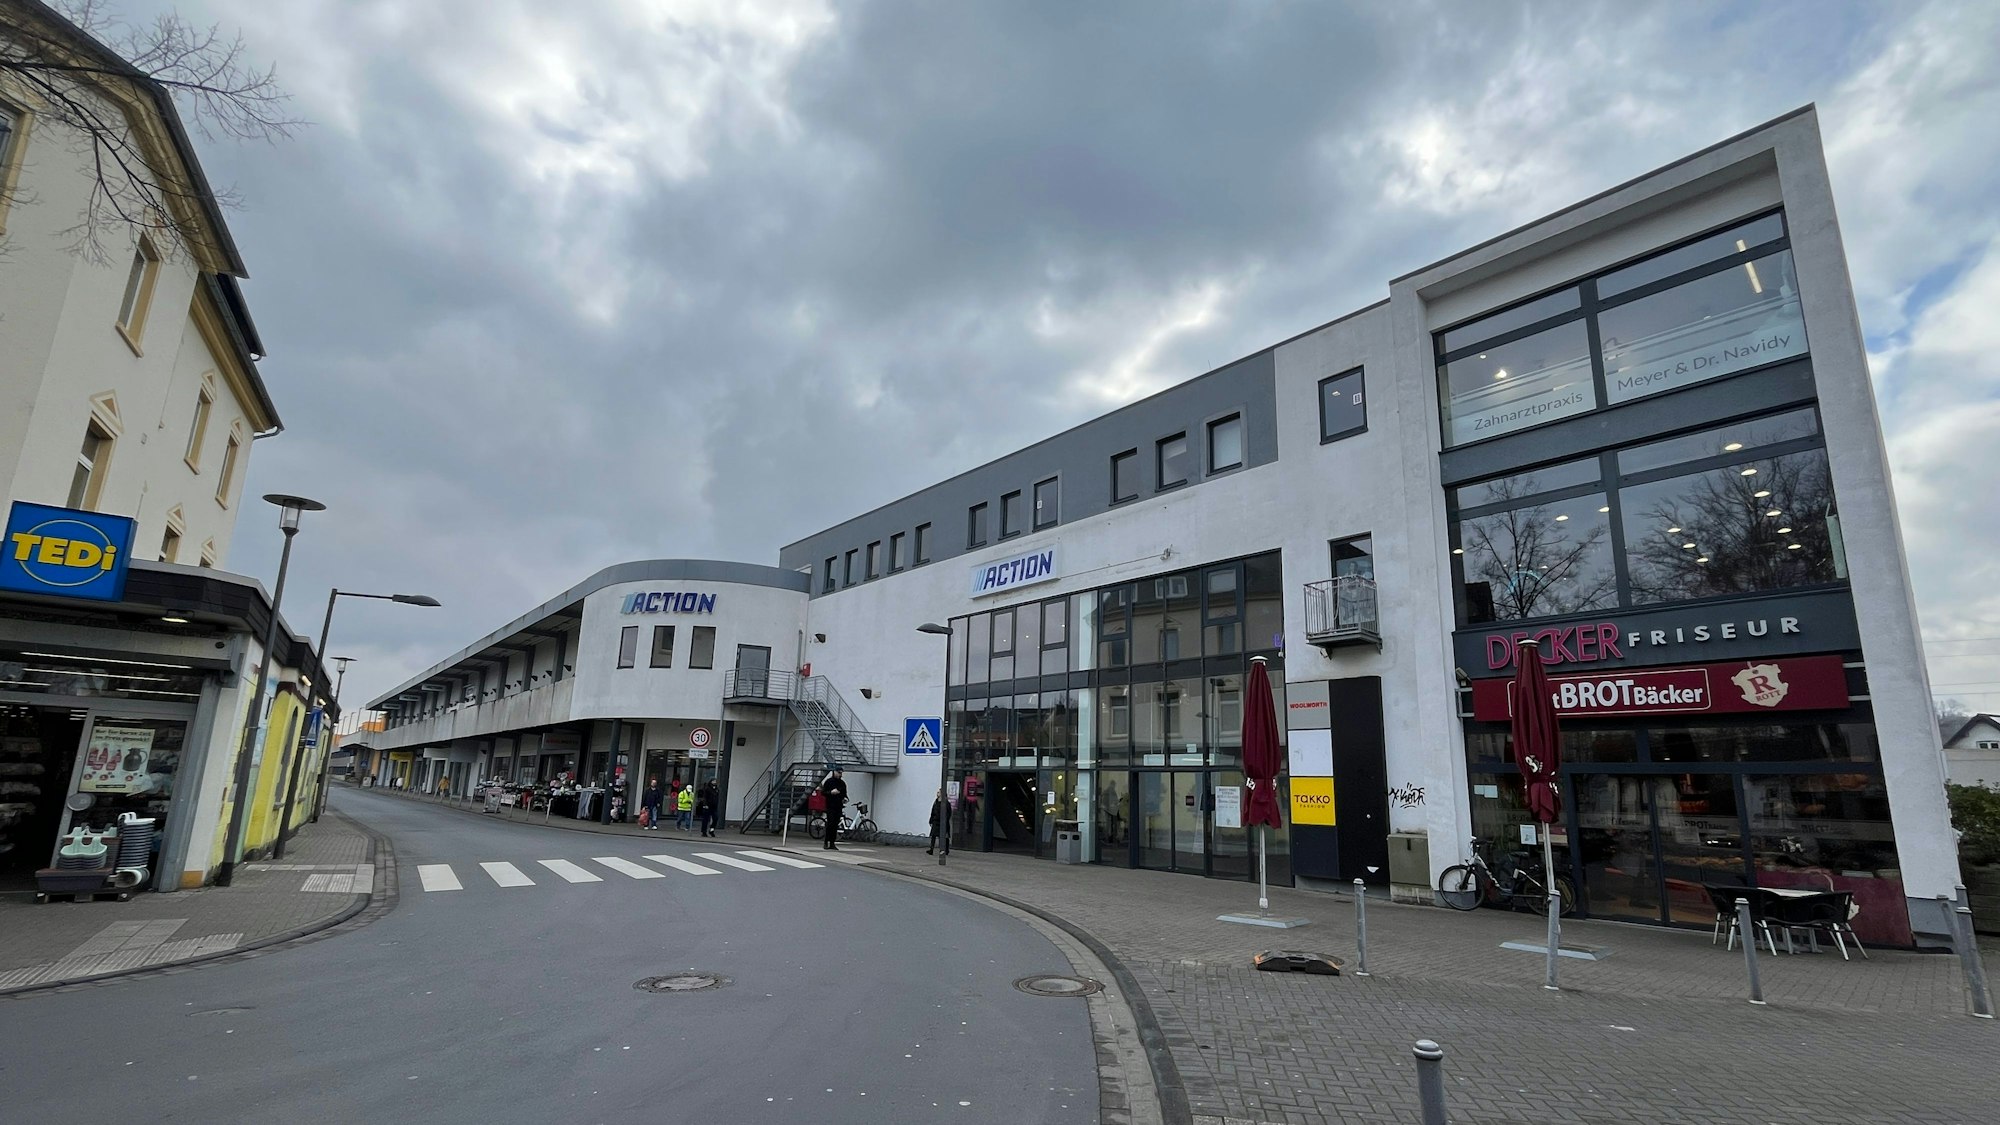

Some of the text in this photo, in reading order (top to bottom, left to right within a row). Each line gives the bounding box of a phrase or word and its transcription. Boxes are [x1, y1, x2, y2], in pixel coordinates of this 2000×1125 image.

[1474, 335, 1791, 431] Zahnarztpraxis Meyer & Dr. Navidy
[12, 532, 117, 571] TEDi
[983, 550, 1053, 590] ACTION
[630, 591, 717, 614] ACTION
[1486, 616, 1801, 670] DECKER FRISEUR
[1552, 679, 1703, 709] tBROTBäcker
[1747, 675, 1777, 695] R
[1755, 690, 1781, 702] ROTT
[694, 733, 706, 743] 30
